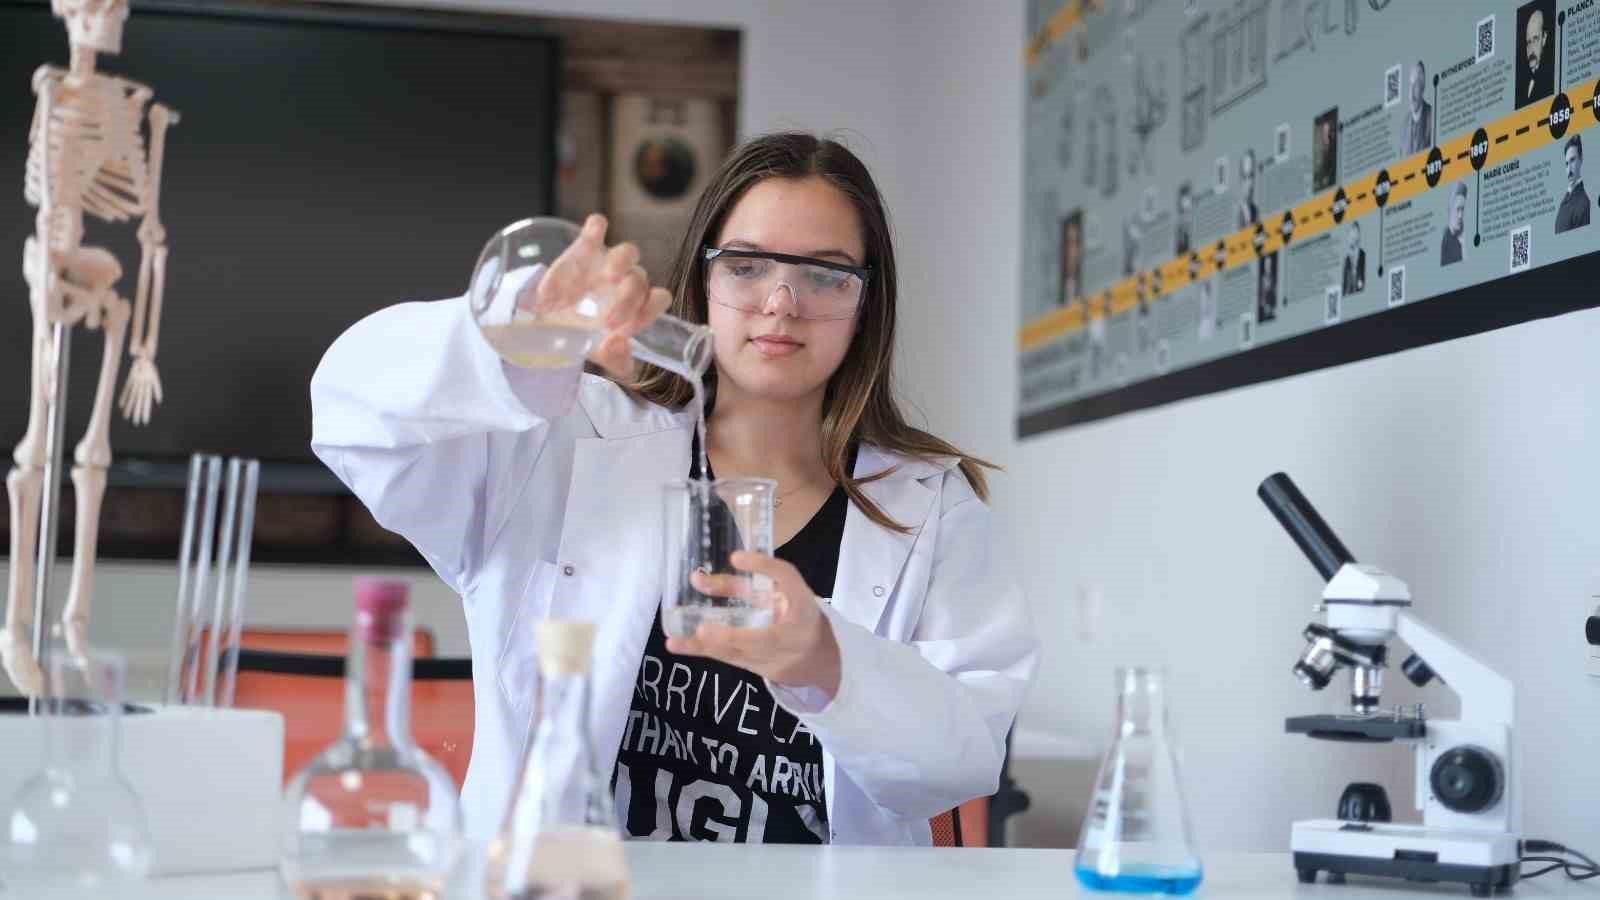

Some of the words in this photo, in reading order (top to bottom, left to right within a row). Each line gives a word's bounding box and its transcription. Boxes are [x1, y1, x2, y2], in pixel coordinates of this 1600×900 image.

[1549, 107, 1570, 126] 1858
[1471, 140, 1488, 159] 1867
[636, 655, 760, 736] RRIVE
[770, 702, 814, 746] LA
[622, 709, 698, 765] THAN
[701, 736, 740, 776] TO
[746, 754, 824, 803] ARRIV
